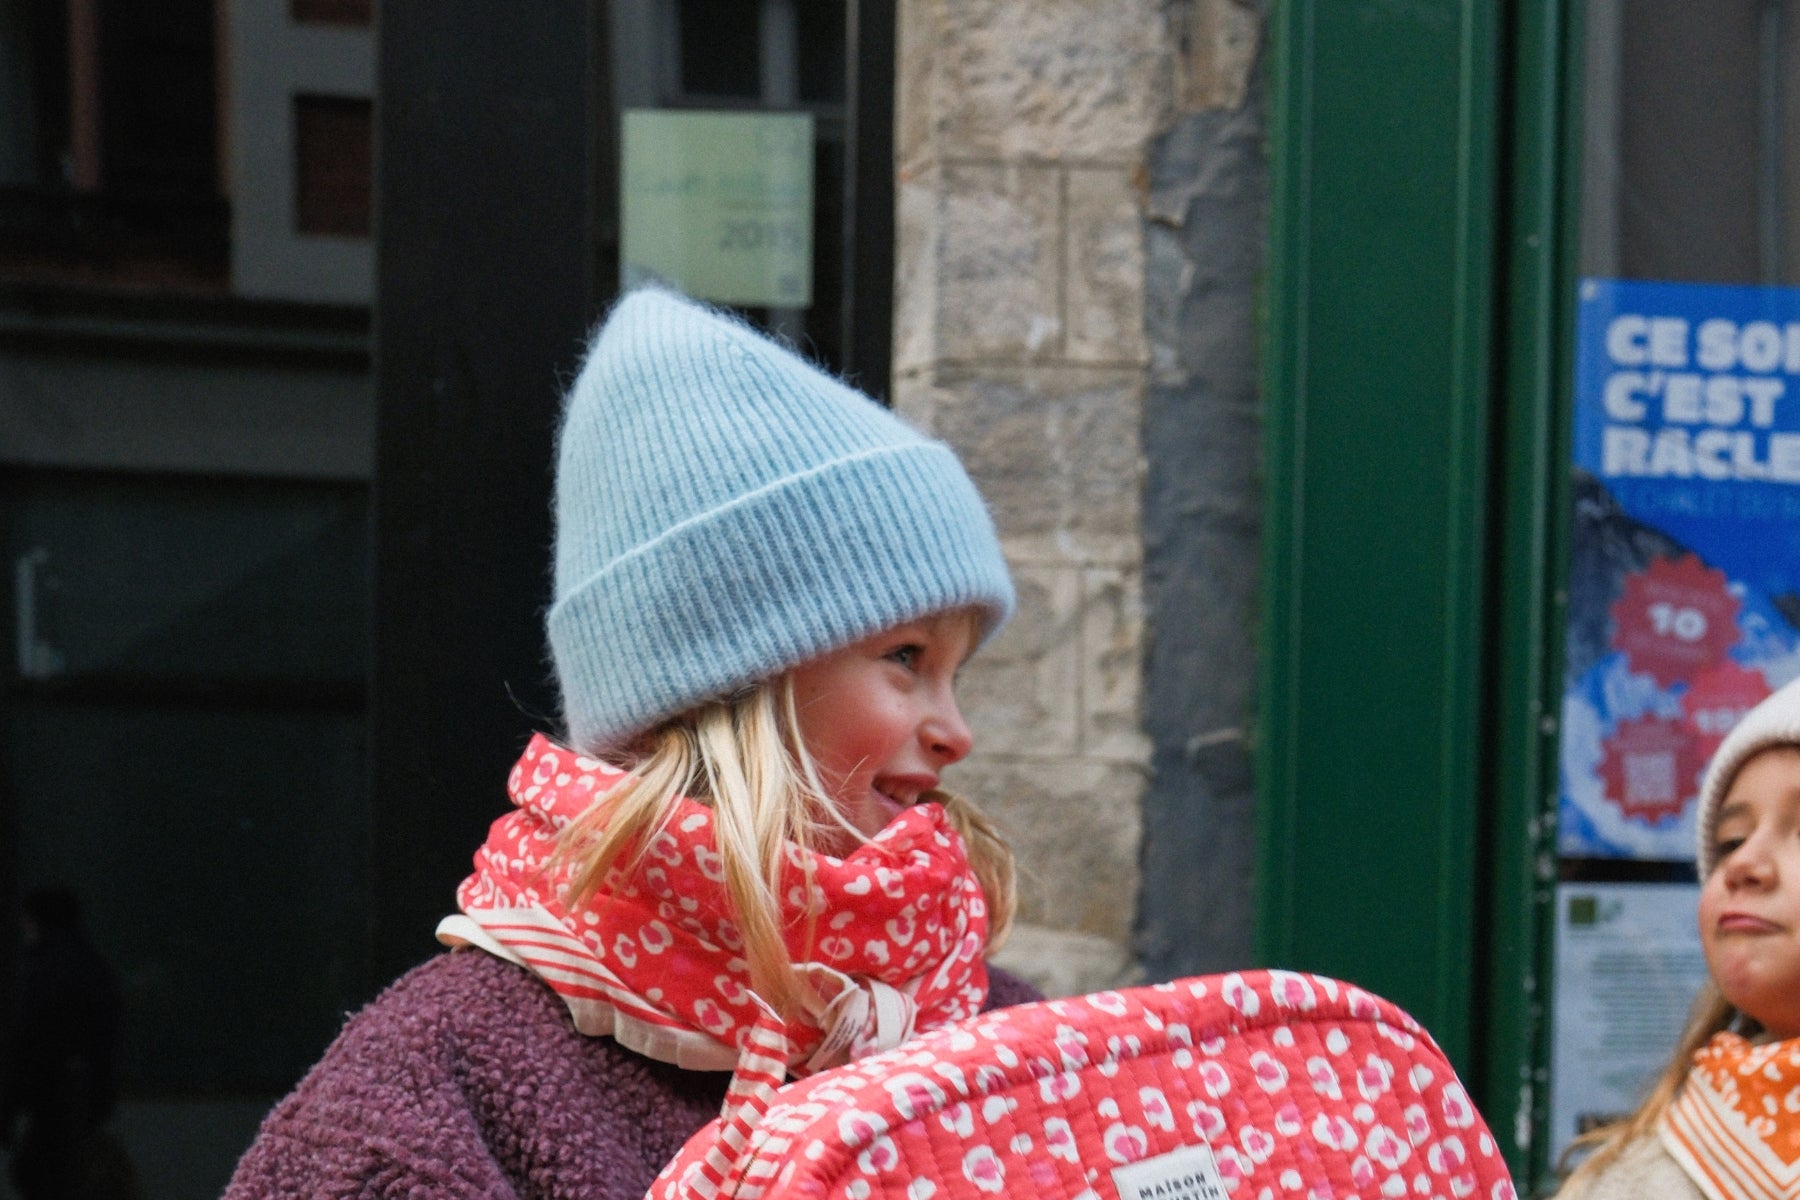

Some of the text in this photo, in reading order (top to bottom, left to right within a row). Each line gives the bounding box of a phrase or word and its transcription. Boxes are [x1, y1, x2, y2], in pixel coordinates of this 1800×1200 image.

[1607, 315, 1688, 366] CE
[1604, 371, 1784, 428] C'EST
[1603, 427, 1800, 483] RACLE
